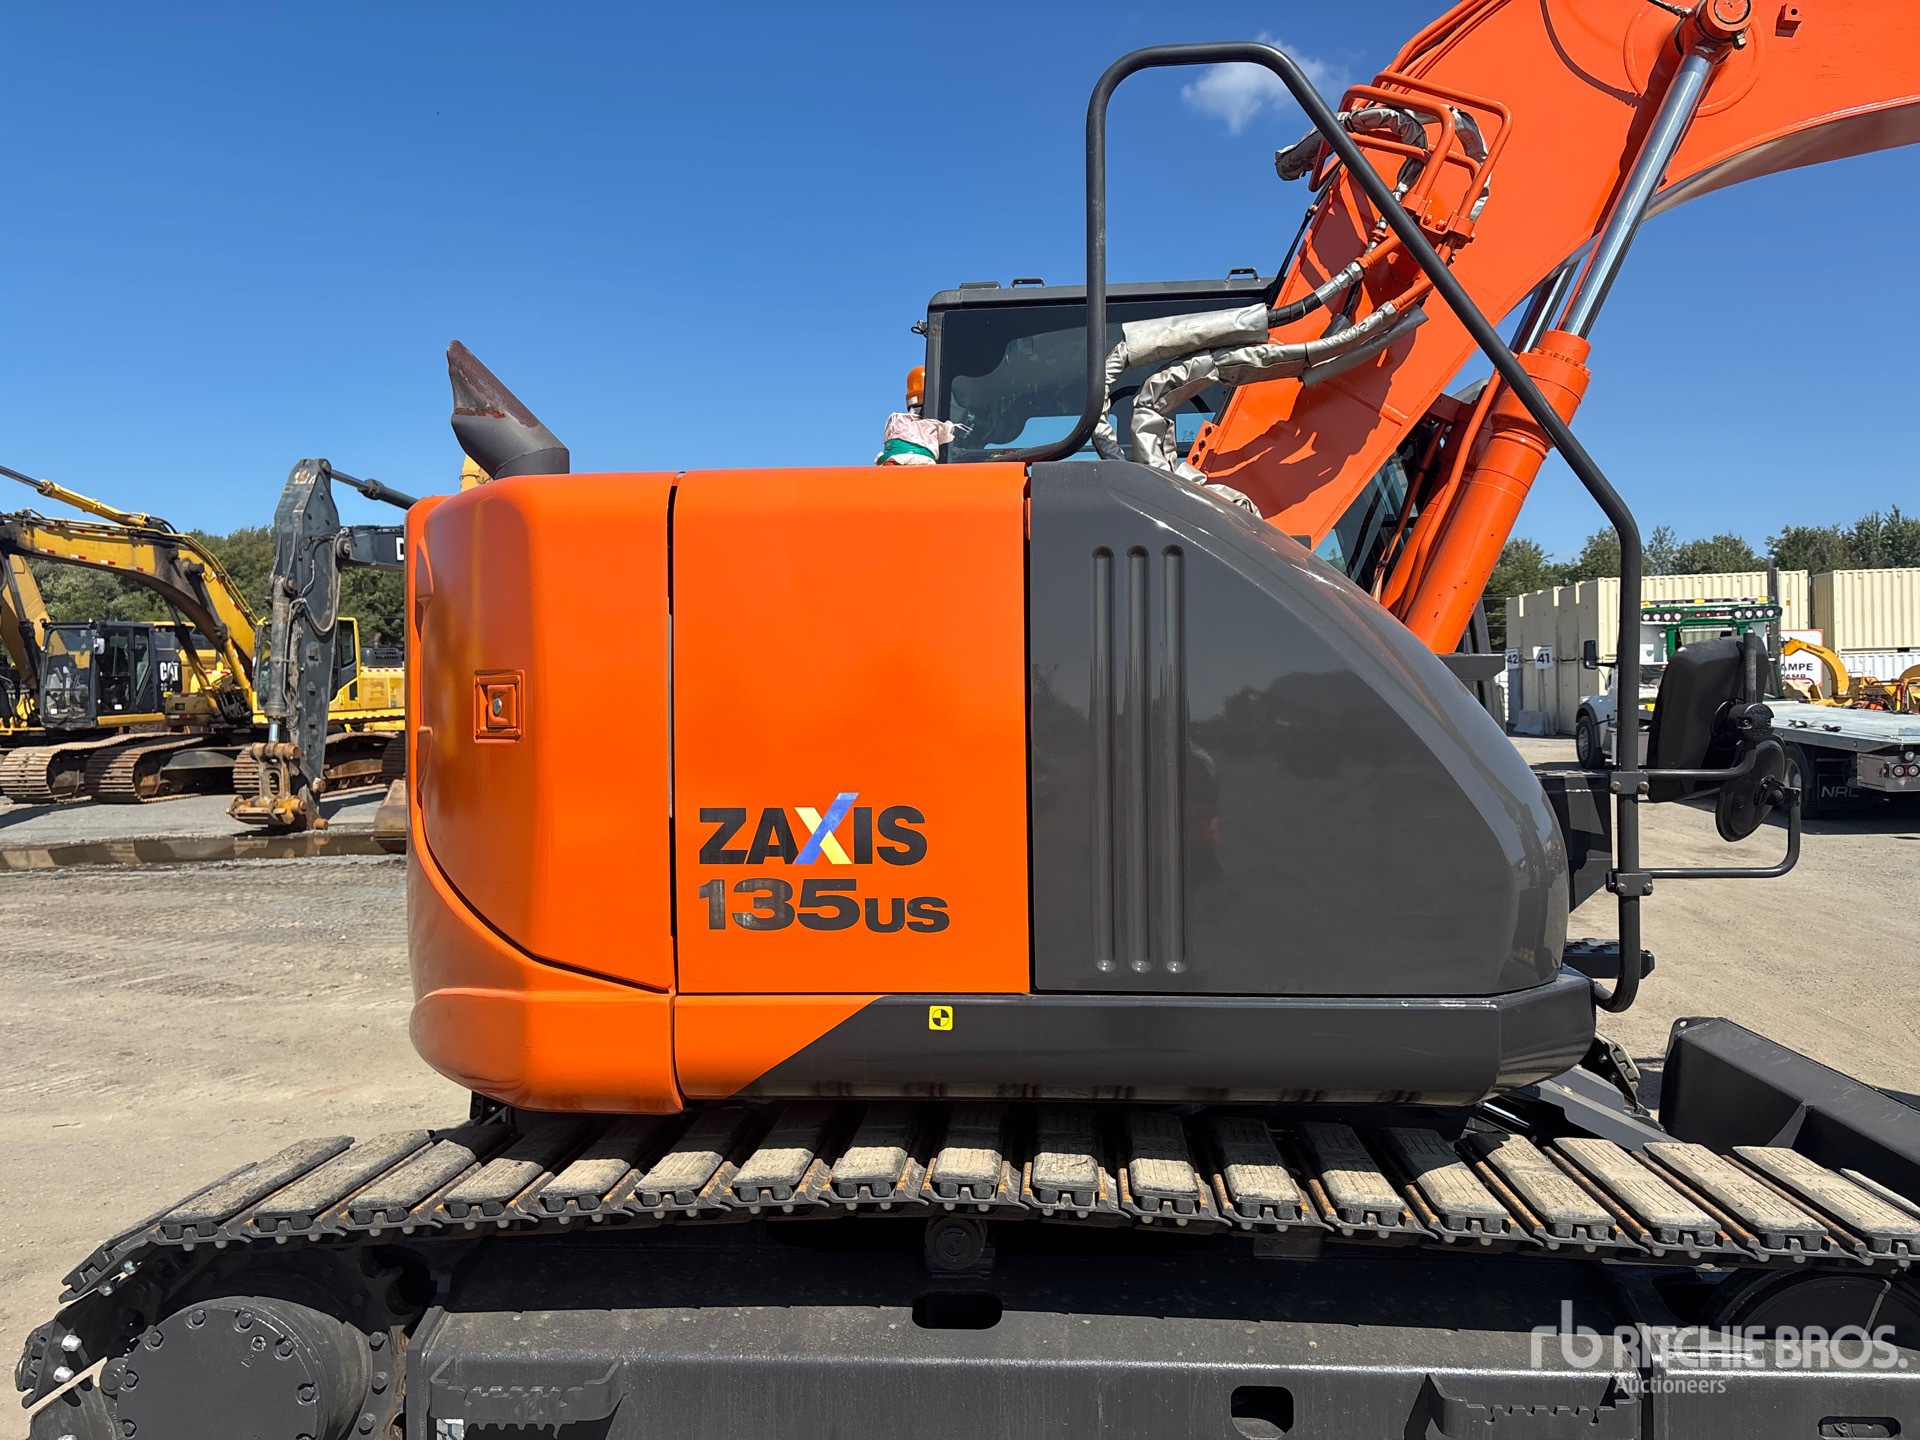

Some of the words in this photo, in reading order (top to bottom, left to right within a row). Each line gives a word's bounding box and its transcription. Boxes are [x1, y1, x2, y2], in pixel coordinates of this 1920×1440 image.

[1507, 654, 1518, 665] 42
[1537, 652, 1551, 664] 41
[160, 661, 179, 682] CAT
[1781, 663, 1814, 671] AMPE
[699, 792, 928, 866] ZAXIS
